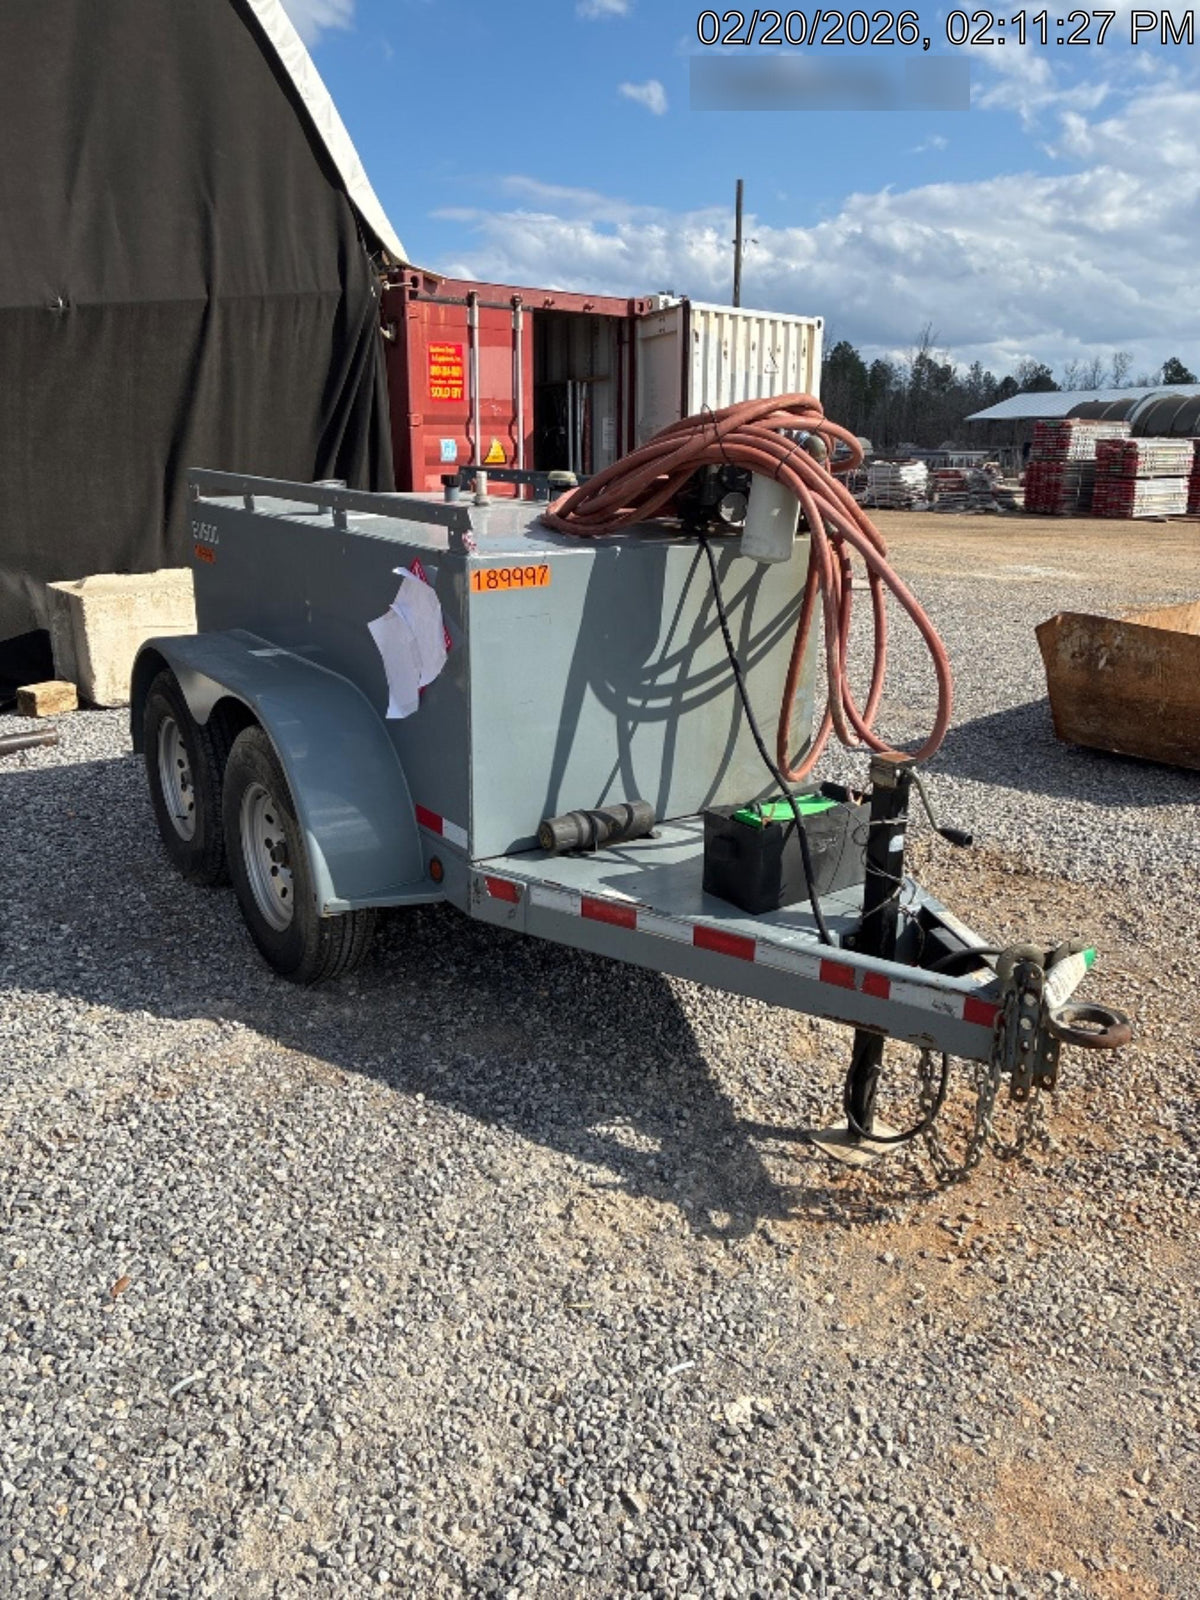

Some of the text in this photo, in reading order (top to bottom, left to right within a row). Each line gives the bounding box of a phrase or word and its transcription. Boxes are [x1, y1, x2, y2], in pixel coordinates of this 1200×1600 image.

[431, 387, 463, 399] SOLD BY
[473, 565, 549, 591] 189997
